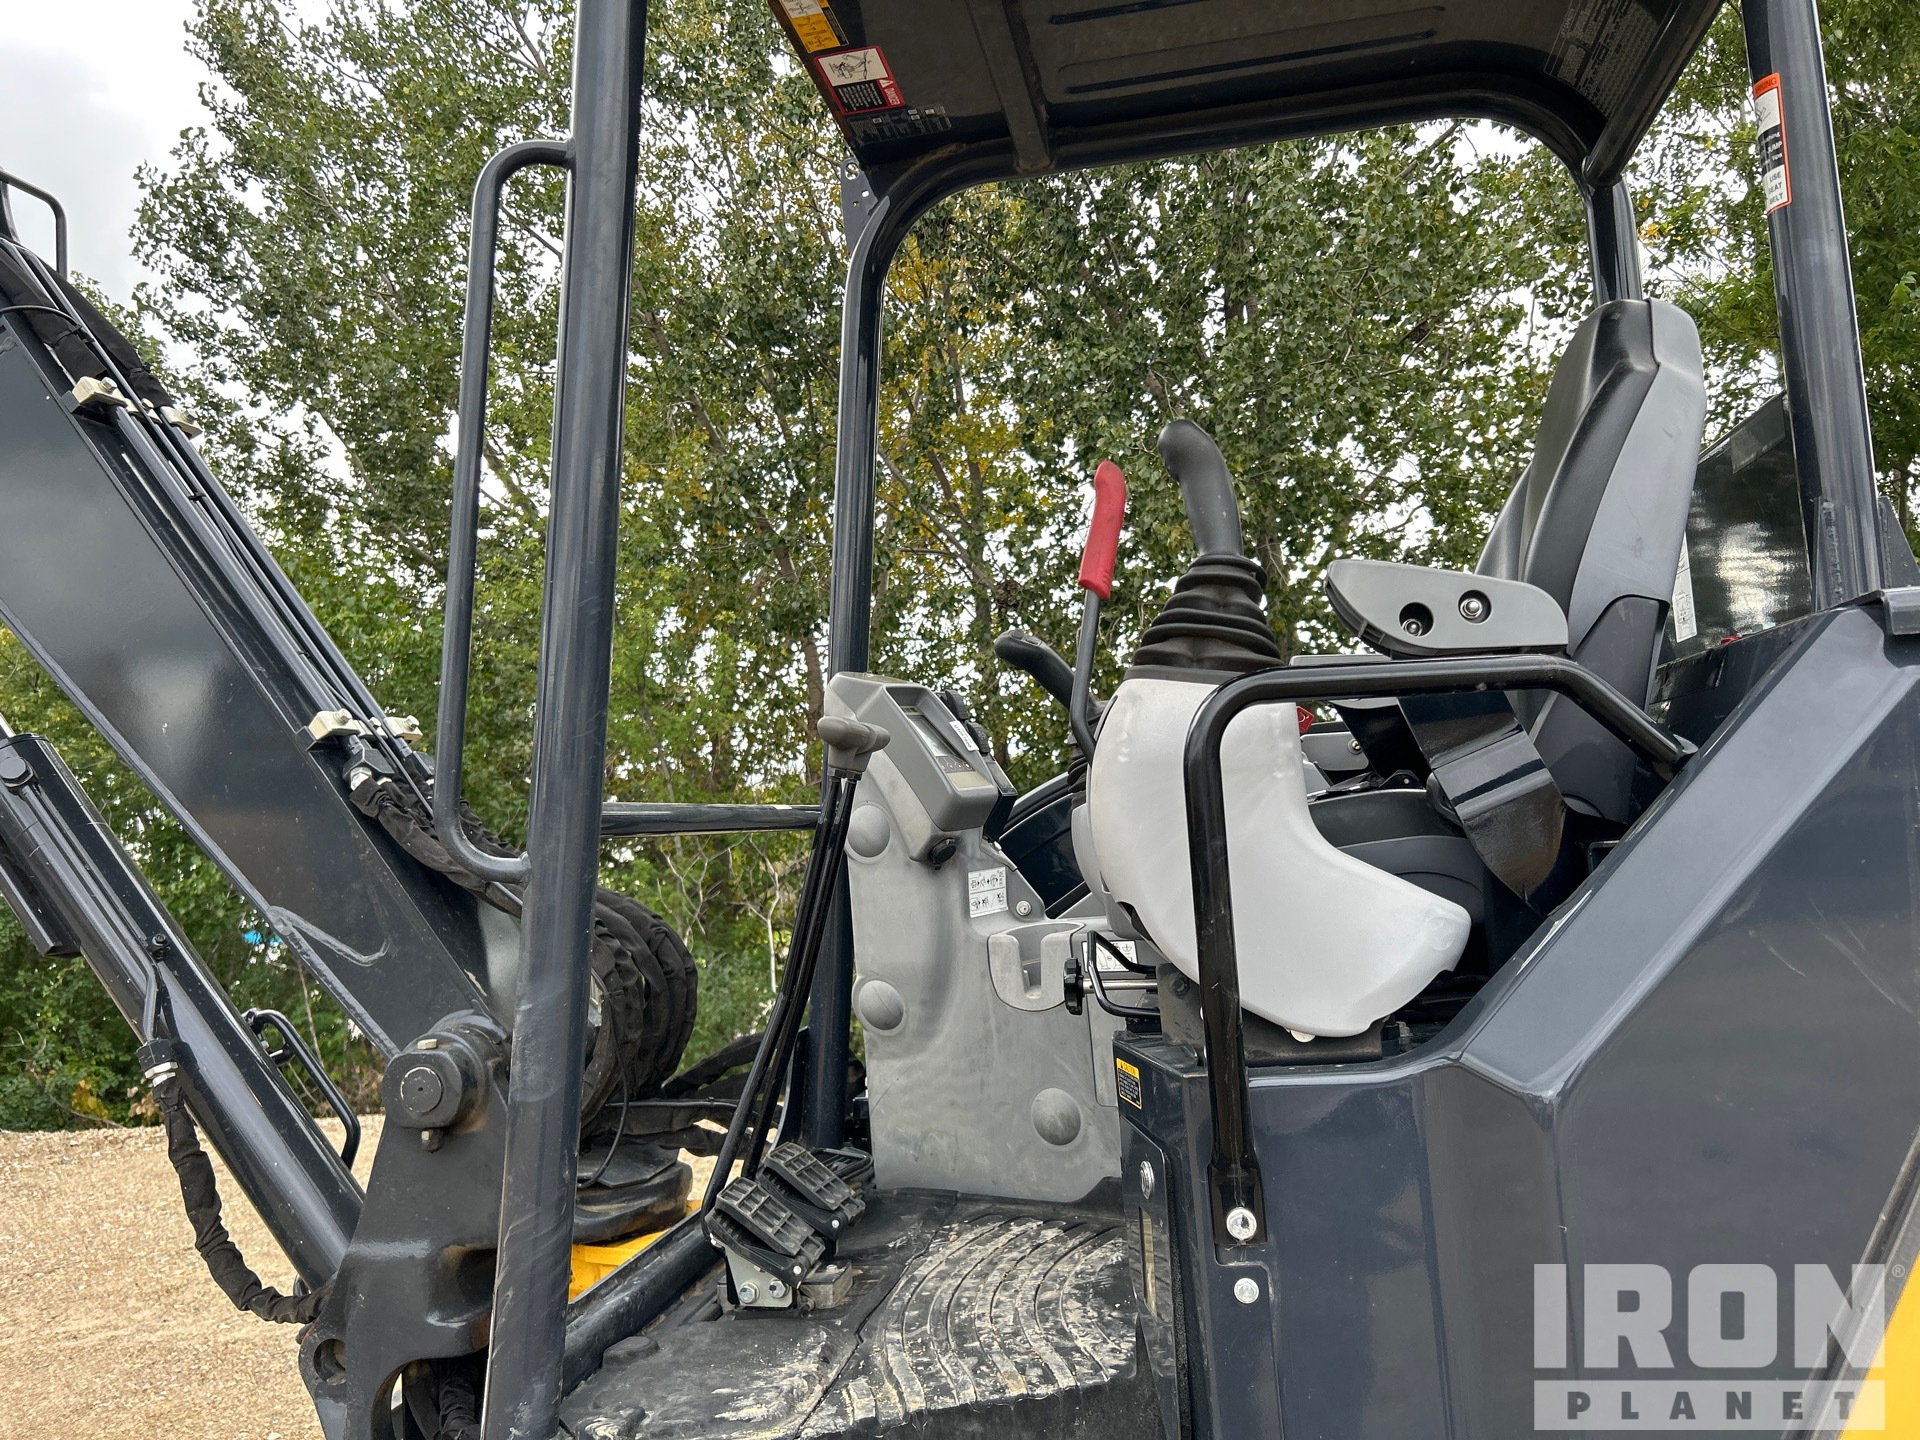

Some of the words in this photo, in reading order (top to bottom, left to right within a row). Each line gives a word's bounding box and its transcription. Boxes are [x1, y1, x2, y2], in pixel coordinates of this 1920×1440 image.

[1767, 140, 1783, 154] JUMP
[1769, 171, 1782, 183] USE
[1768, 181, 1783, 194] SEAT
[1769, 192, 1784, 205] BELT
